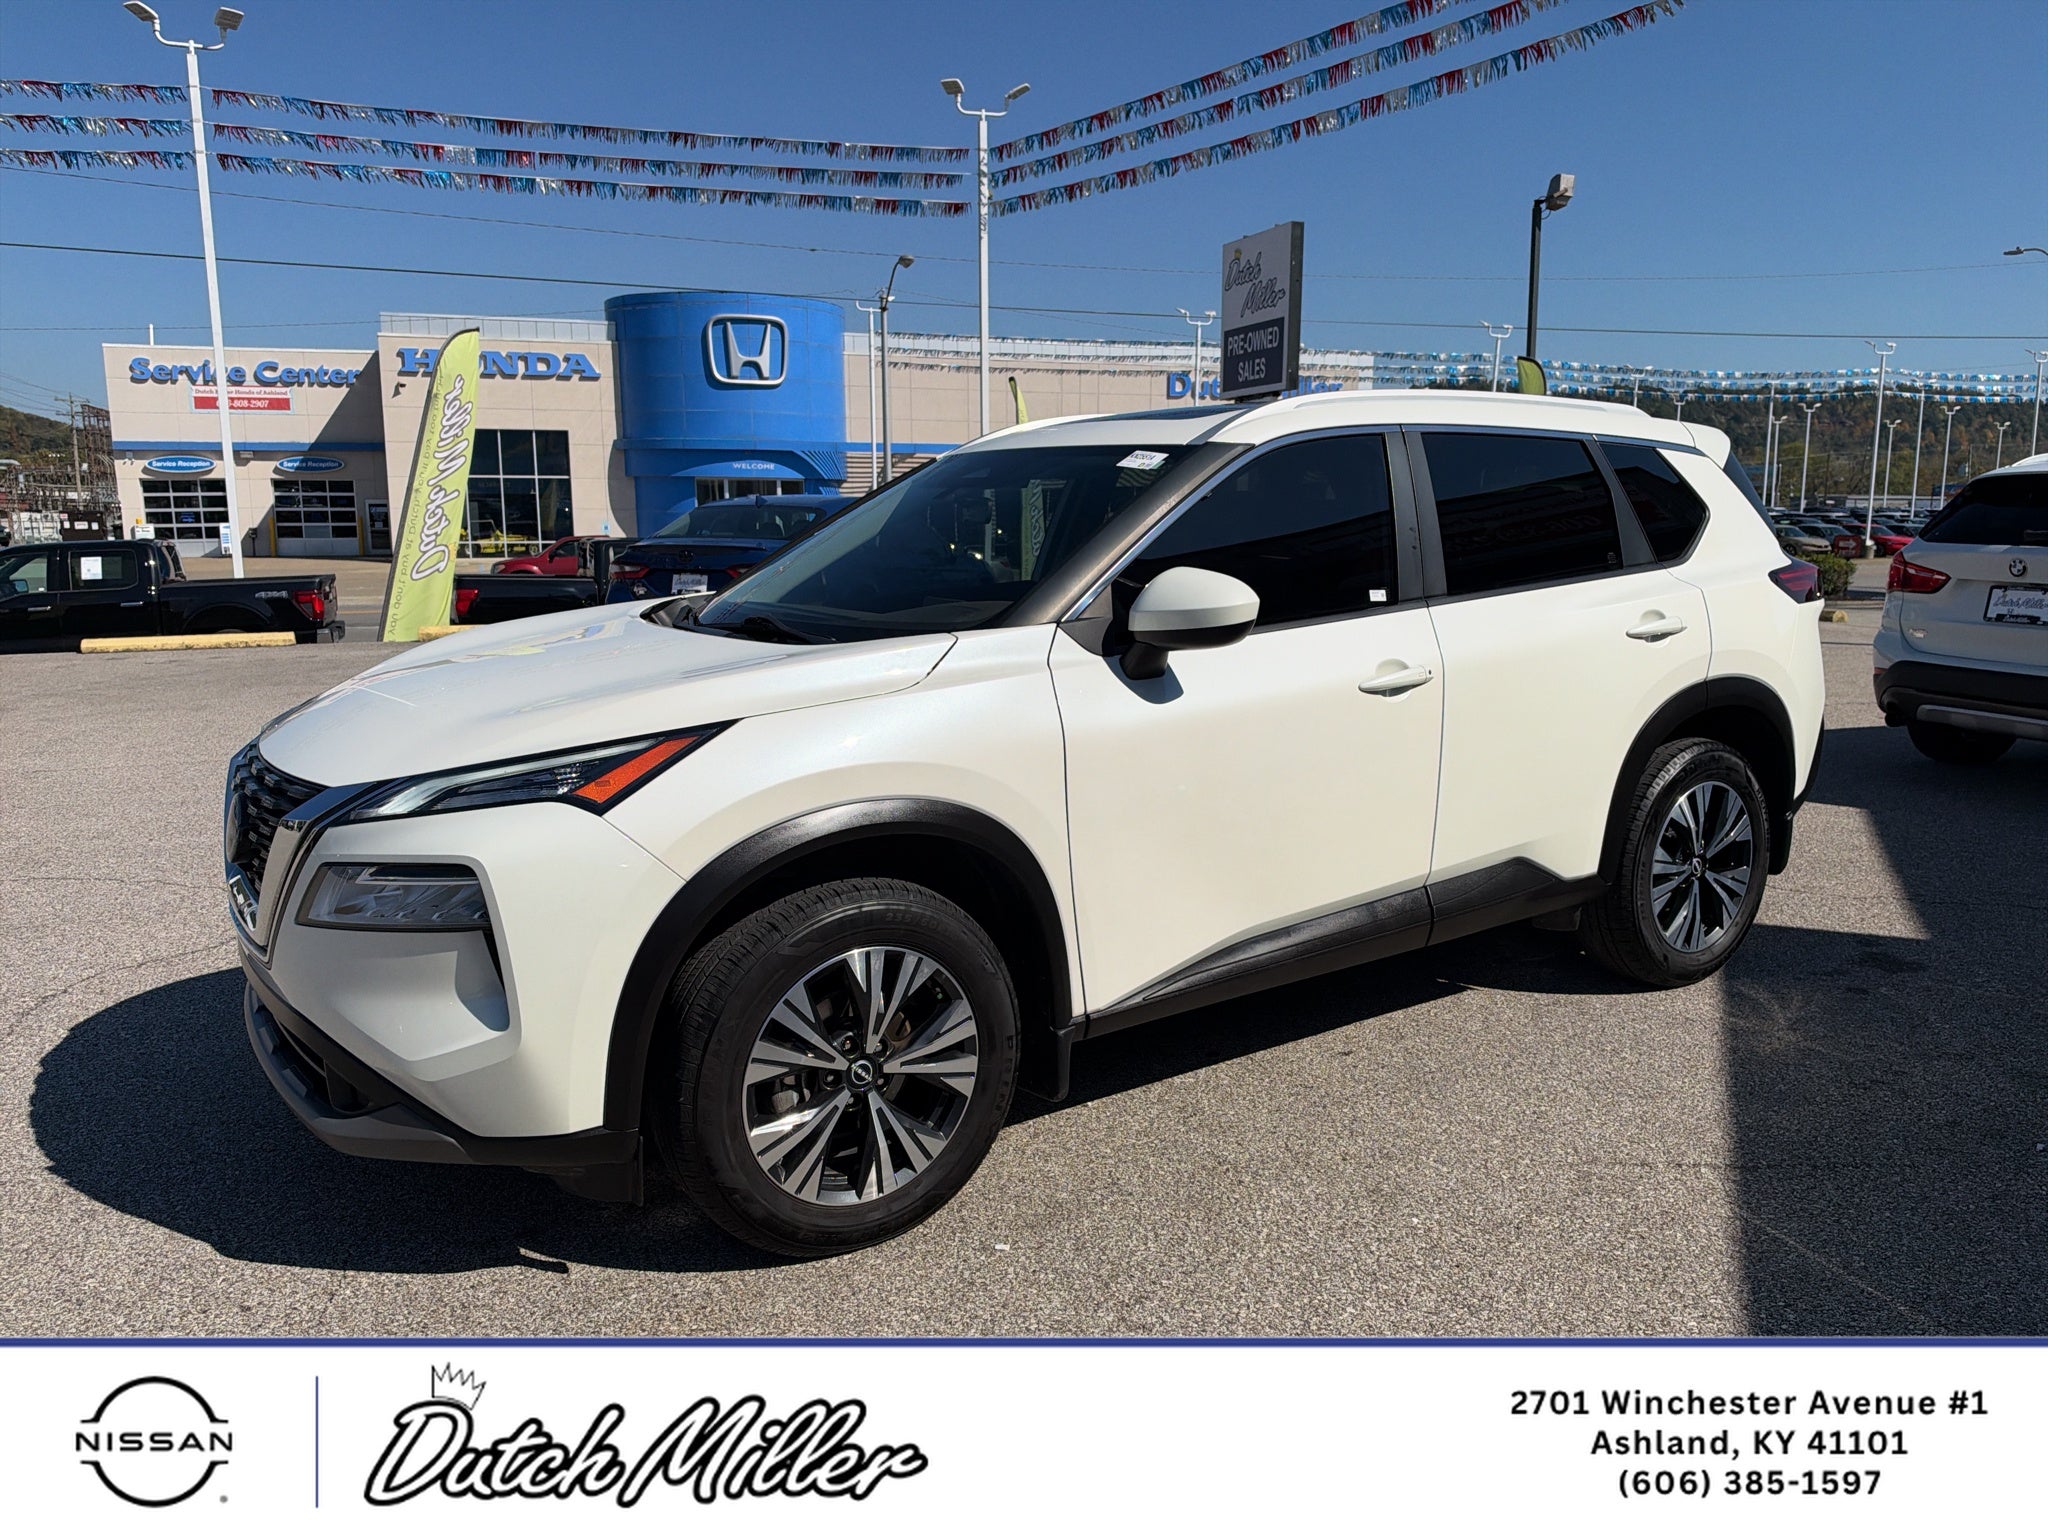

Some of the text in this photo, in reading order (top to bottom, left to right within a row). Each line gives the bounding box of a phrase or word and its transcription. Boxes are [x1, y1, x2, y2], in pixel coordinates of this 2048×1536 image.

[1224, 251, 1262, 292] Dutch
[1240, 277, 1286, 318] Miller
[1227, 326, 1280, 357] PRE-OWNED
[130, 358, 362, 386] Servie Center
[398, 348, 601, 380] HNDA
[1238, 357, 1266, 382] SALES
[1169, 372, 1221, 398] Dut
[216, 399, 270, 408] -808-2907
[178, 460, 211, 468] Reception
[307, 460, 339, 469] Reception
[732, 462, 776, 470] WELCOME
